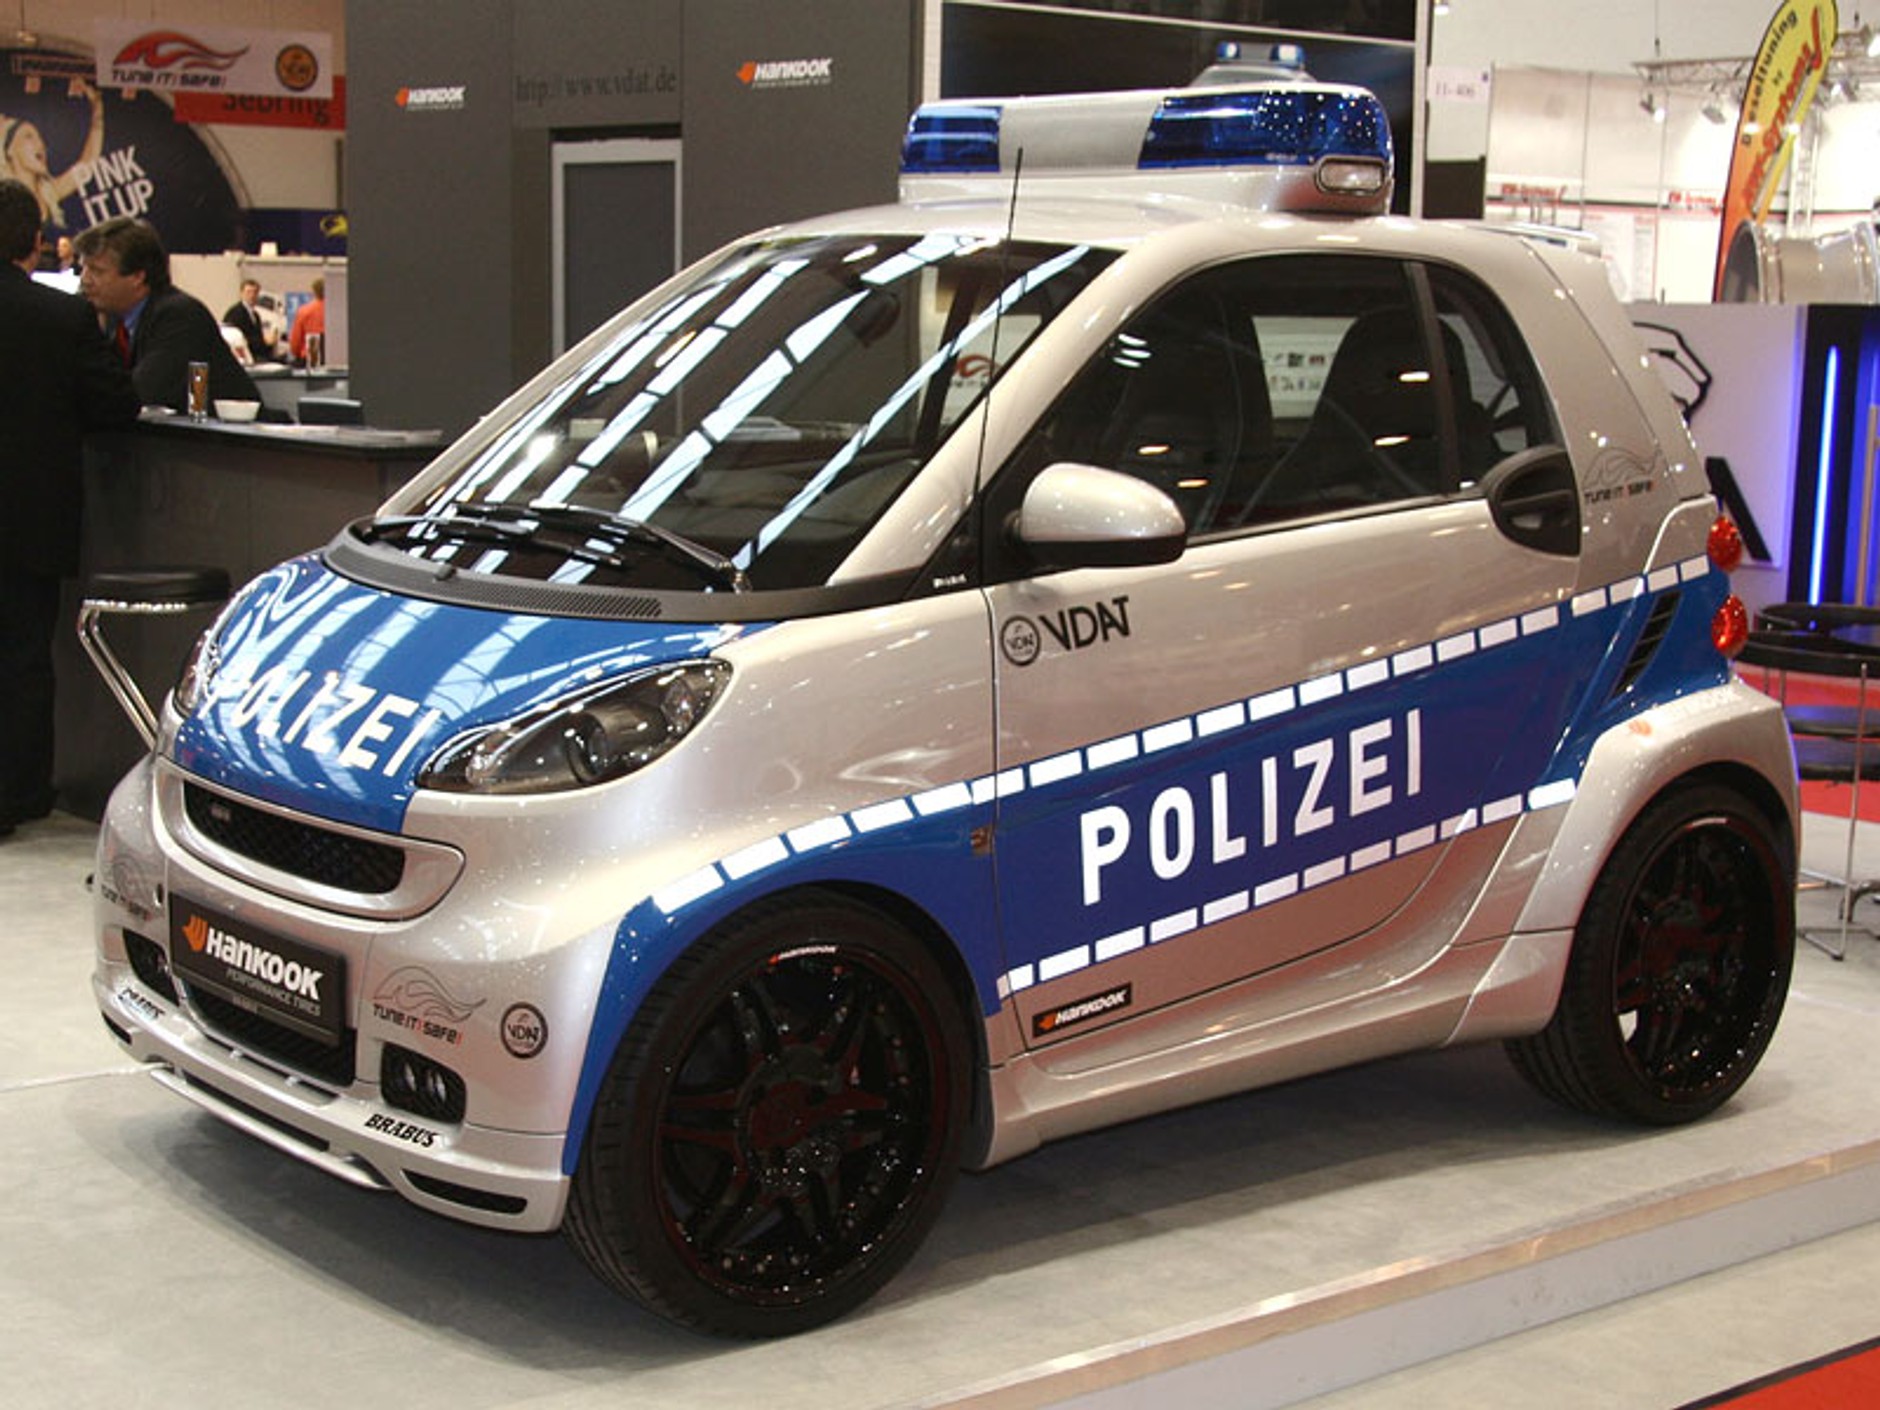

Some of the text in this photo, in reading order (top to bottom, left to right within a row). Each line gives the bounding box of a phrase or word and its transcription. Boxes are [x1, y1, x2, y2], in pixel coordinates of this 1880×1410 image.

[1741, 9, 1799, 146] Deseltuning
[73, 145, 146, 198] PINK
[112, 178, 154, 218] UP
[1038, 596, 1130, 651] VDAT
[1080, 708, 1421, 906] POLIZEI
[365, 1113, 440, 1147] BRABUS
